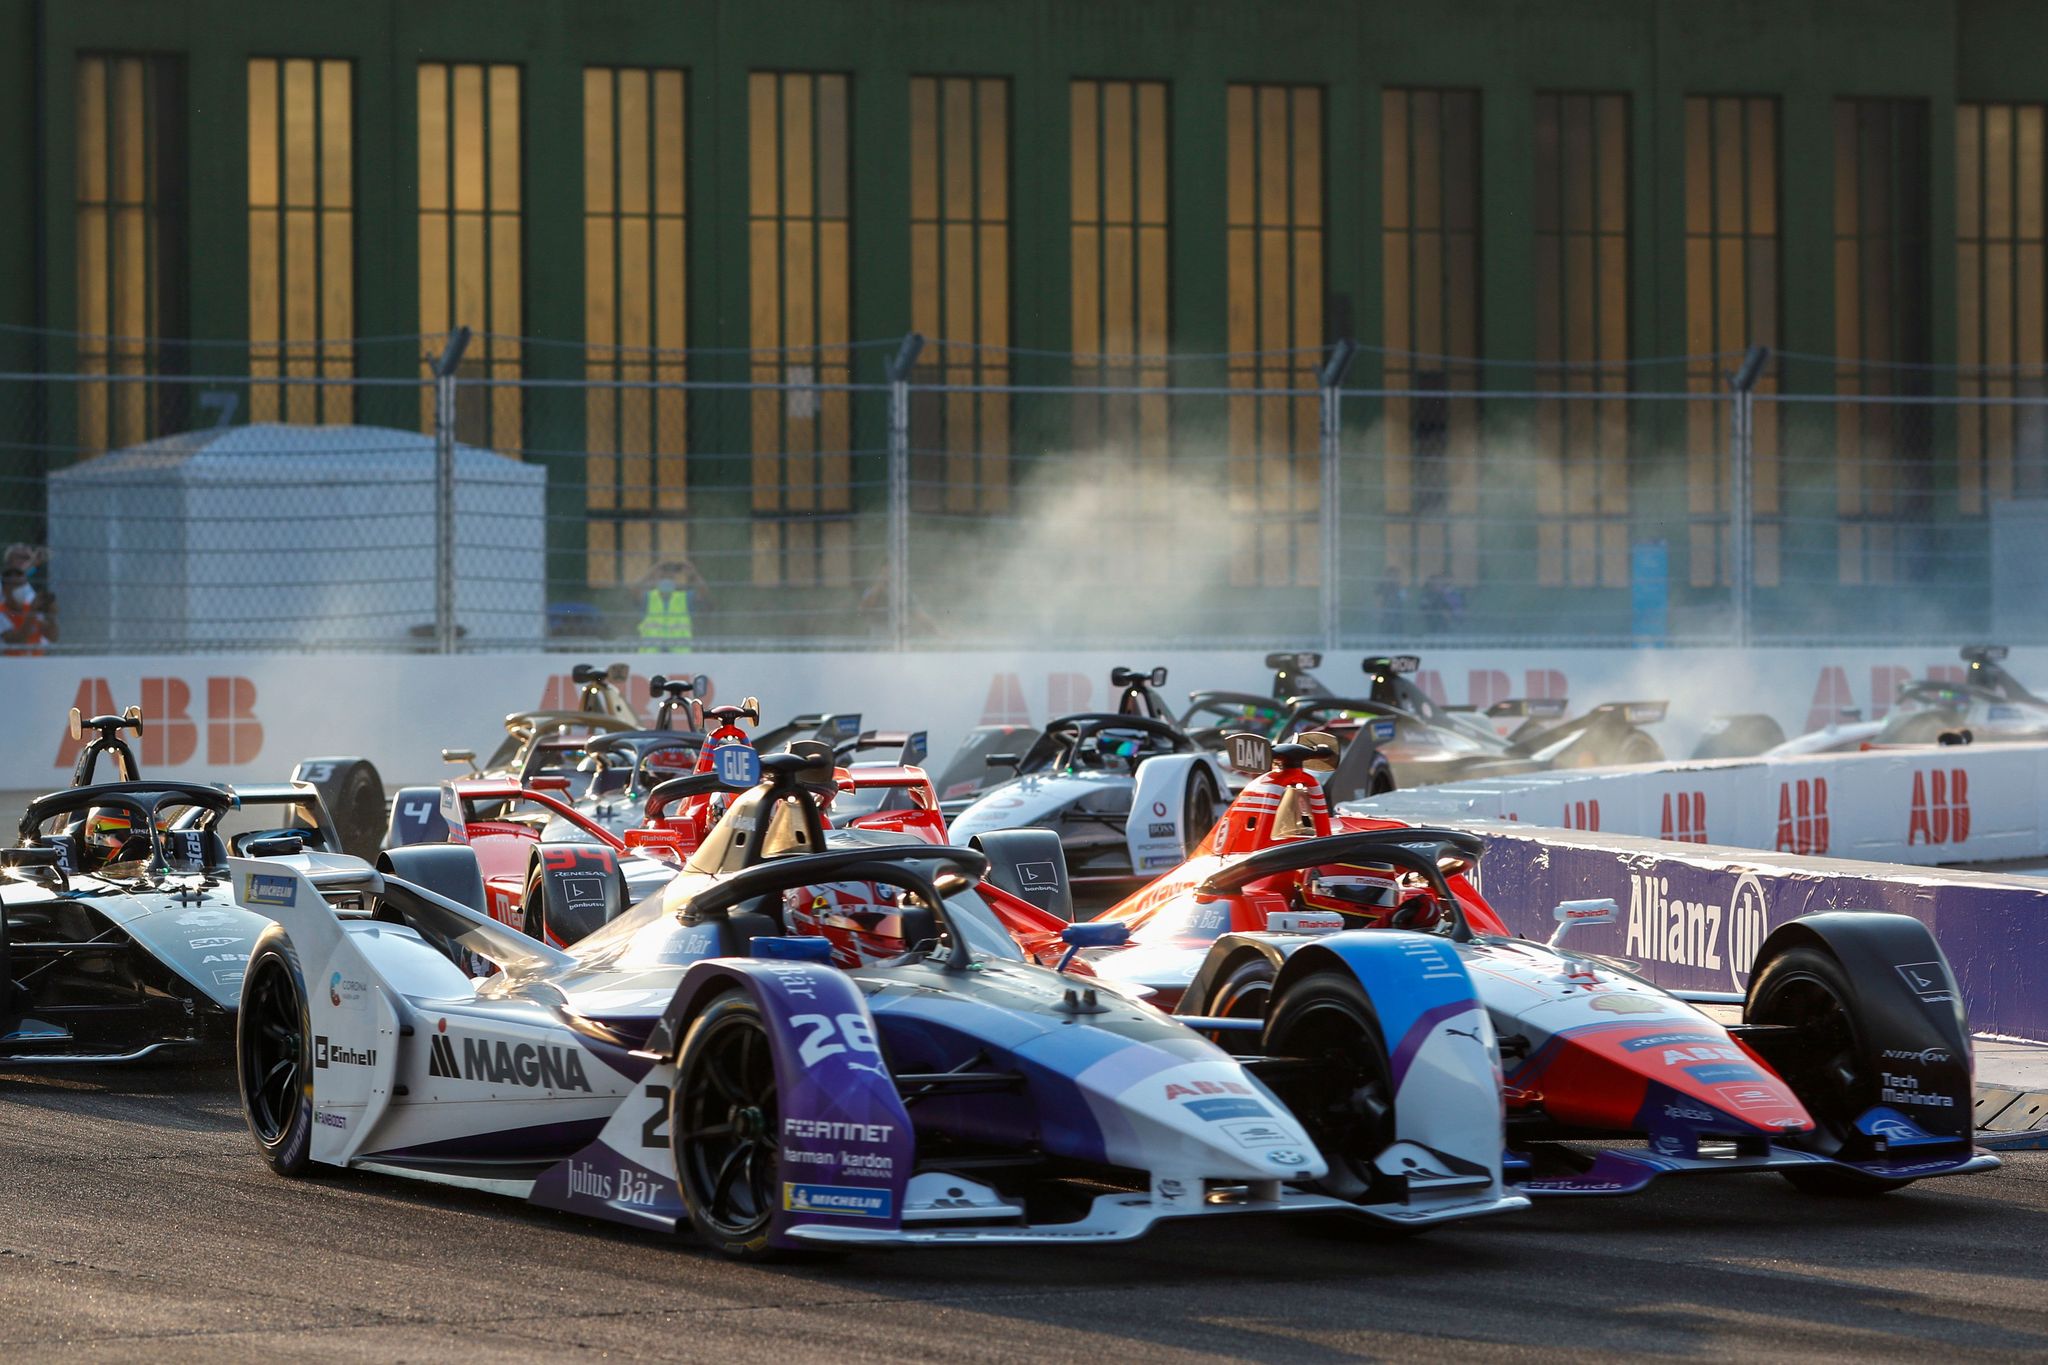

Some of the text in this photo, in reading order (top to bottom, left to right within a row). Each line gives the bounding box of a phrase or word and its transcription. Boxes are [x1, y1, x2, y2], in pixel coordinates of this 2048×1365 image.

[55, 677, 265, 768] ABB
[724, 750, 750, 781] GUE
[1235, 739, 1265, 770] DAM
[299, 764, 336, 782] 13
[403, 802, 432, 824] 4
[1776, 777, 1829, 855] ABB
[1908, 769, 1971, 846] ABB
[544, 847, 613, 873] 94
[258, 885, 293, 898] MICHELIN
[1626, 874, 1722, 970] Allianz
[191, 938, 232, 947] SAP
[684, 934, 711, 955] Bär
[331, 1045, 377, 1066] Einhell
[464, 1037, 593, 1092] MAGNA
[1663, 1047, 1745, 1065] ABB
[1165, 1081, 1252, 1100] ABB
[1881, 1072, 1918, 1088] Tech
[1881, 1088, 1954, 1107] Mahindra
[785, 1118, 894, 1143] FORTINET
[567, 1159, 664, 1206] Julius Bär
[811, 1194, 882, 1208] MICHELIN
